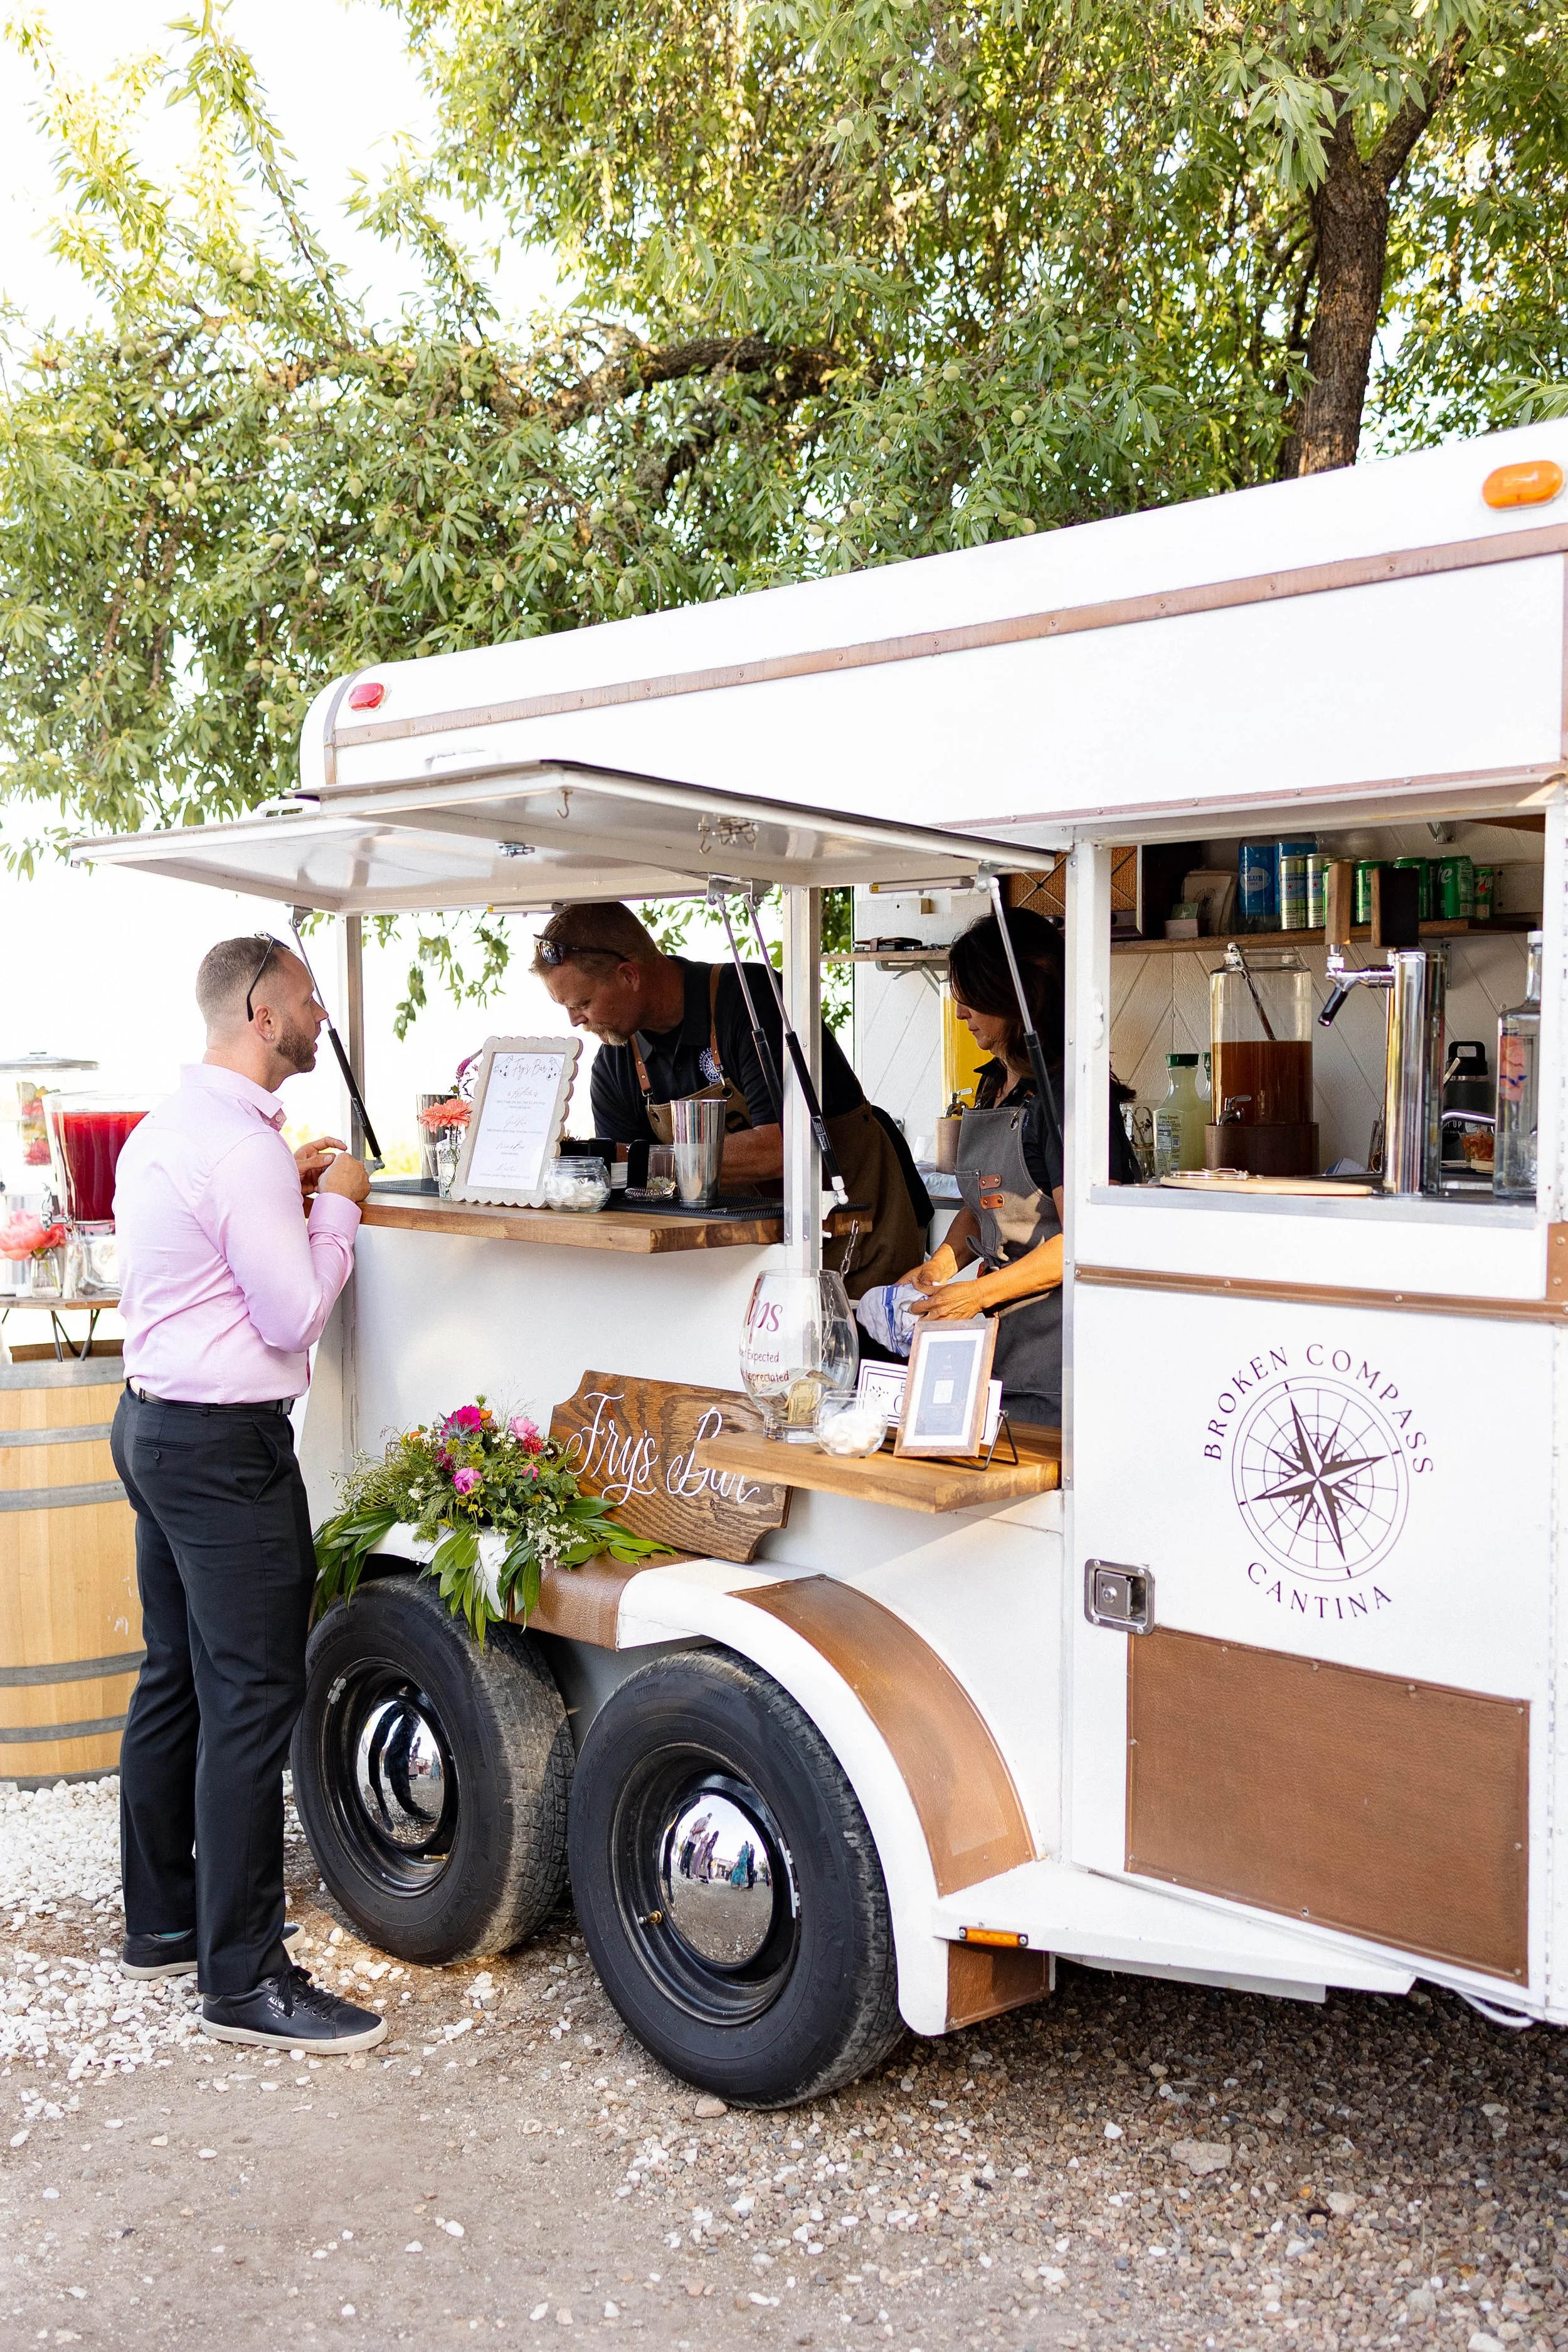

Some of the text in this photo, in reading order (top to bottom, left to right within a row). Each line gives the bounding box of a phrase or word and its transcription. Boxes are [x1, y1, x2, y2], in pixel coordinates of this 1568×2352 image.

[747, 1278, 783, 1345] ips
[747, 1348, 780, 1365] Expected
[1204, 1344, 1433, 1473] BROKEN COMPASS
[564, 1392, 659, 1506] Fry's
[1248, 1562, 1392, 1619] CANTINA
[268, 1996, 295, 2017] ALLSAS
